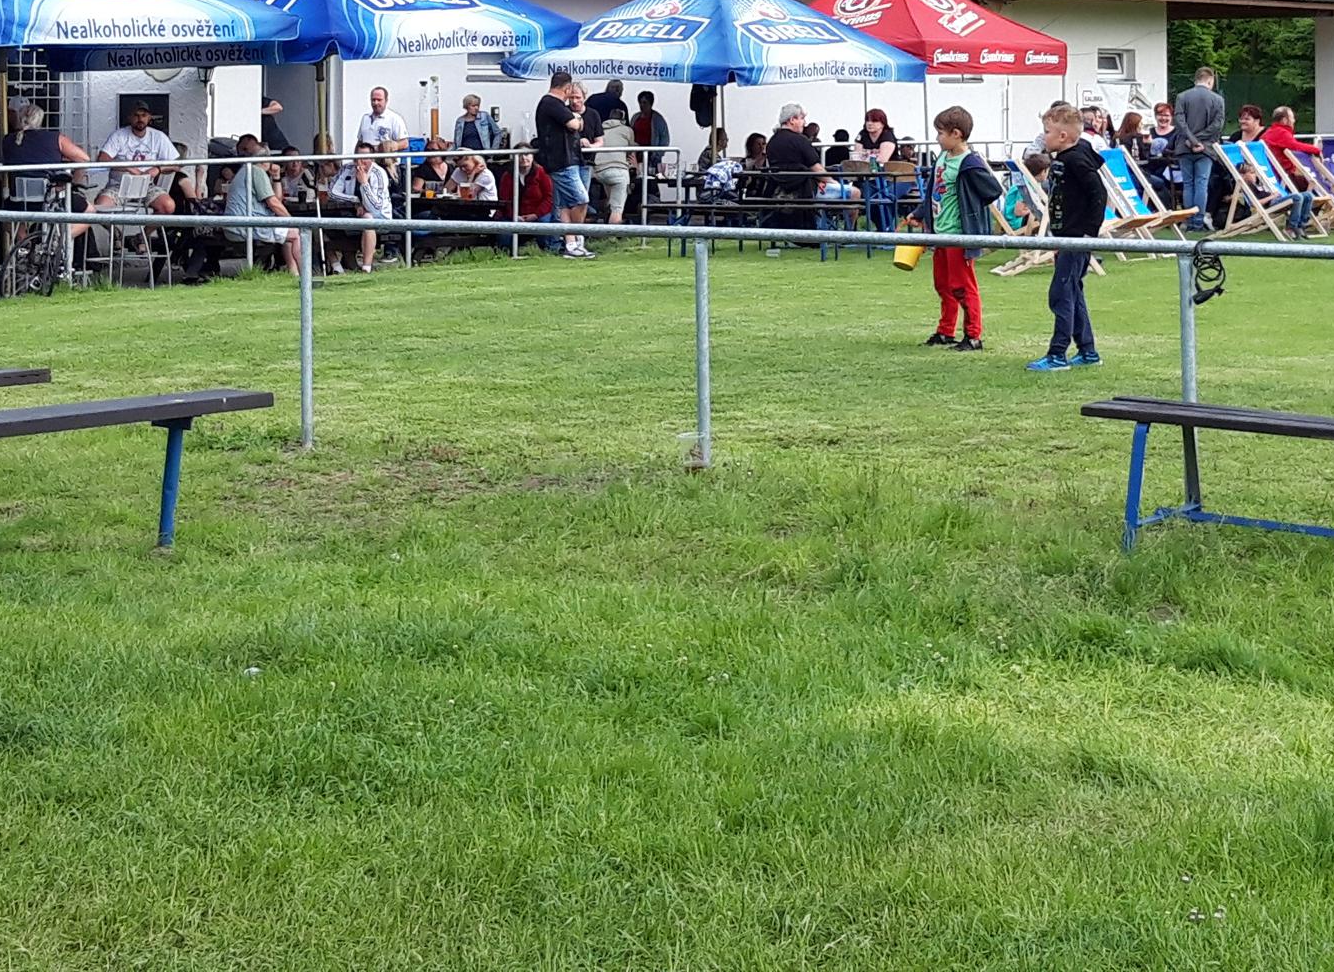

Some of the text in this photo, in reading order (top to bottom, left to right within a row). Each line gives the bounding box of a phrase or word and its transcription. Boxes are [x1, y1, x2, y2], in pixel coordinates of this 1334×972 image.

[56, 17, 235, 40] Nealkoholické osvěžení
[594, 23, 689, 39] BIRELL
[748, 24, 839, 42] BIRELL
[398, 30, 531, 54] Nealkoholické osvěžení
[107, 46, 202, 68] Nealkoholické
[548, 60, 678, 78] Nealkoholické osvěžení
[779, 60, 888, 80] Nealkoholické osvěžení
